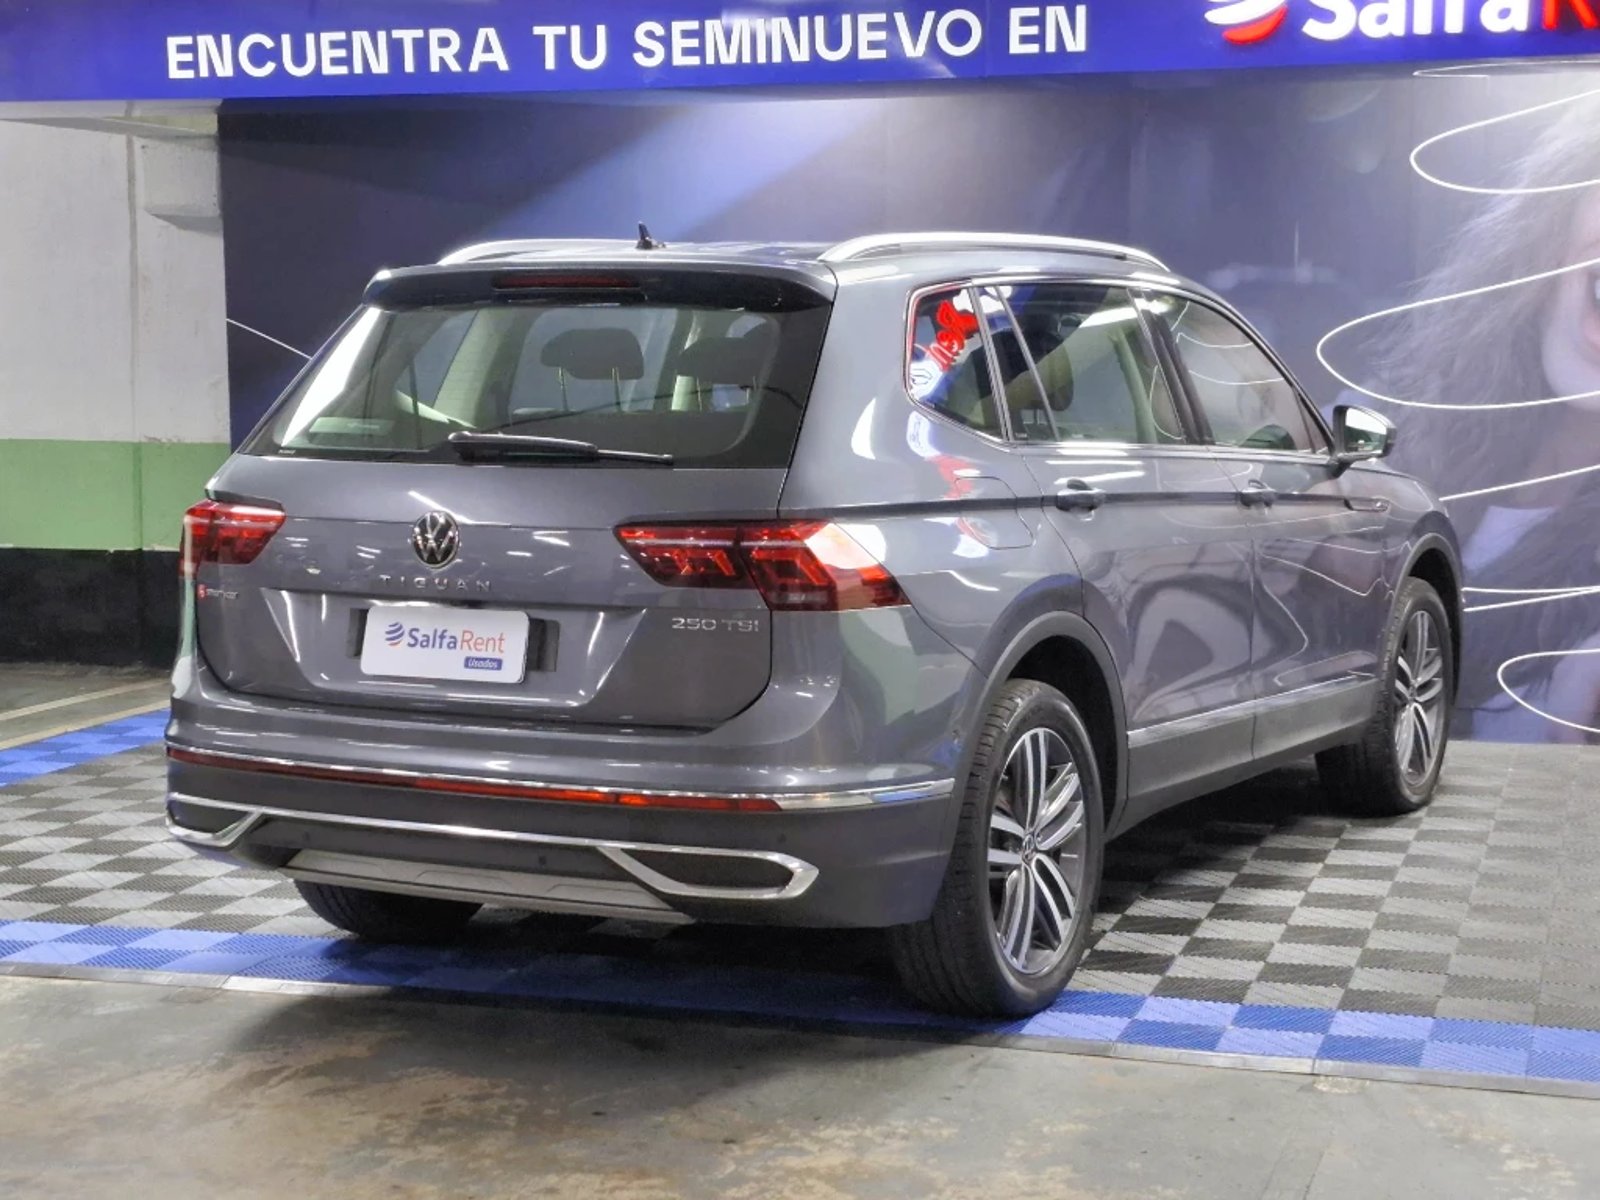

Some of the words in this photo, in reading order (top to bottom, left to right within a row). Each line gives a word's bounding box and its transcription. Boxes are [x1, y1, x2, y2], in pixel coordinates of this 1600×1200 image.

[167, 27, 509, 79] ENCUENTRA
[533, 24, 607, 71] TU
[633, 9, 982, 68] SEMINUEVO
[1009, 4, 1088, 54] EN
[379, 574, 492, 593] TIGUAN
[671, 617, 717, 631] 250
[721, 619, 759, 632] TSI
